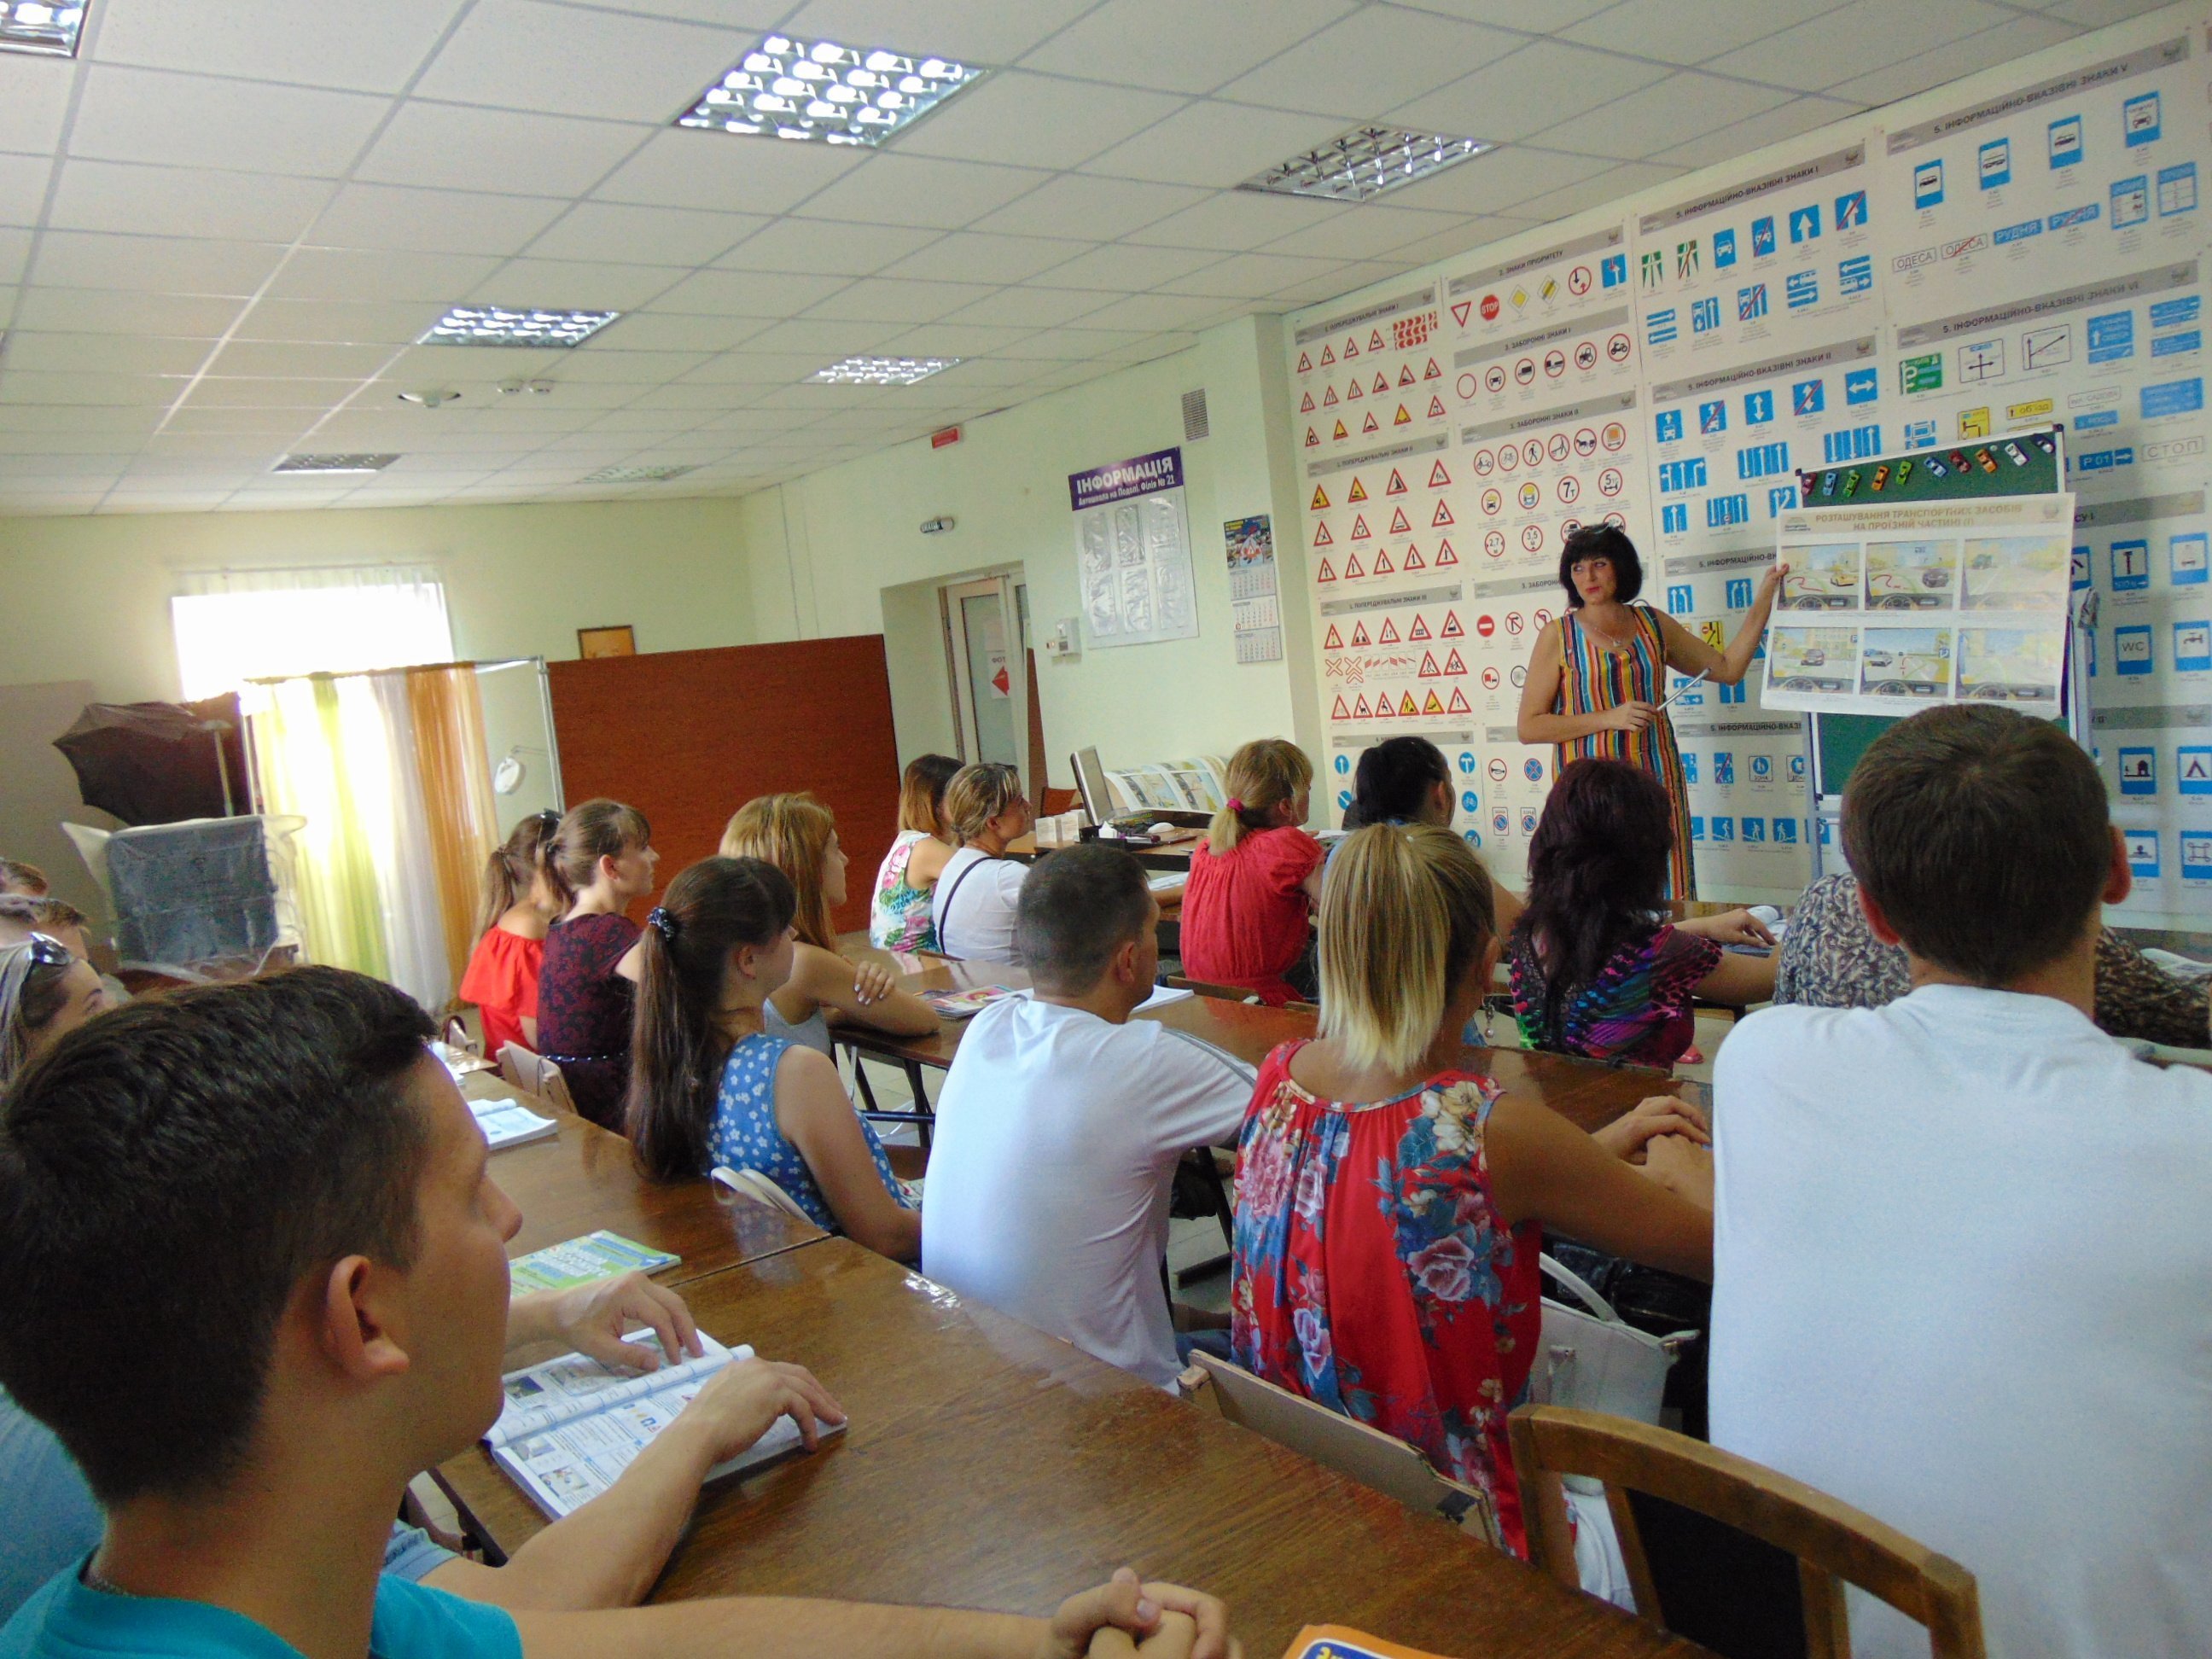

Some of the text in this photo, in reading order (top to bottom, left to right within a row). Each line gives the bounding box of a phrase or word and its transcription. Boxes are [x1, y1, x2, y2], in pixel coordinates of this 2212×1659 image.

[1995, 222, 2038, 242] РУДНЯ
[1897, 252, 1933, 269] ОДЕСА
[1481, 301, 1499, 313] STOP
[1796, 354, 1824, 366] ЗНАКИ
[2147, 440, 2199, 458] СТОП
[1077, 457, 1173, 494] ІНФОРМАЦІЯ
[1167, 474, 1175, 485] 21
[1816, 510, 1890, 523] РОЗТАШУВАННЯ
[1893, 507, 1971, 520] ТРАНСПОРТНИХ
[1854, 522, 1866, 532] НА
[1868, 519, 1915, 531] ПРОЇЗНІЙ
[2122, 641, 2145, 652] WC
